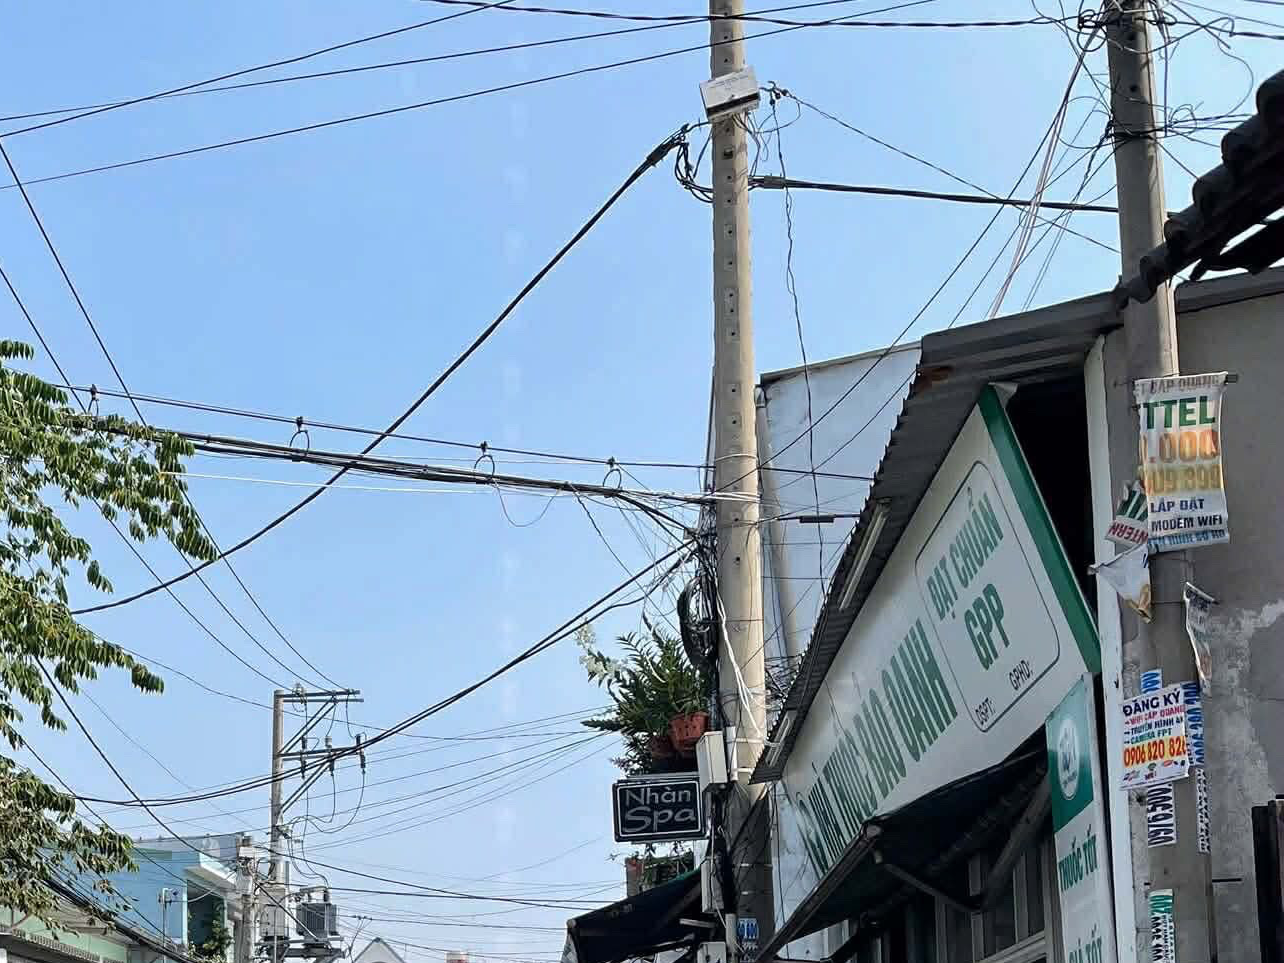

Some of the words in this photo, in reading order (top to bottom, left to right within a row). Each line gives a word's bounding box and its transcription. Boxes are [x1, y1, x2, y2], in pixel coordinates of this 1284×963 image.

[1150, 516, 1194, 532] MODEM
[1197, 513, 1223, 528] WIFI
[963, 583, 1010, 671] GPP
[888, 617, 958, 764] OANH
[1122, 696, 1160, 716] ĐĂNG
[1164, 687, 1181, 706] KÝ
[1157, 727, 1172, 738] FPT
[1123, 743, 1146, 767] 0906
[1147, 738, 1165, 760] 820
[624, 784, 692, 806] Nhàn
[623, 806, 697, 833] Spa
[1059, 836, 1084, 893] THUỐC
[1083, 823, 1099, 878] TỐT
